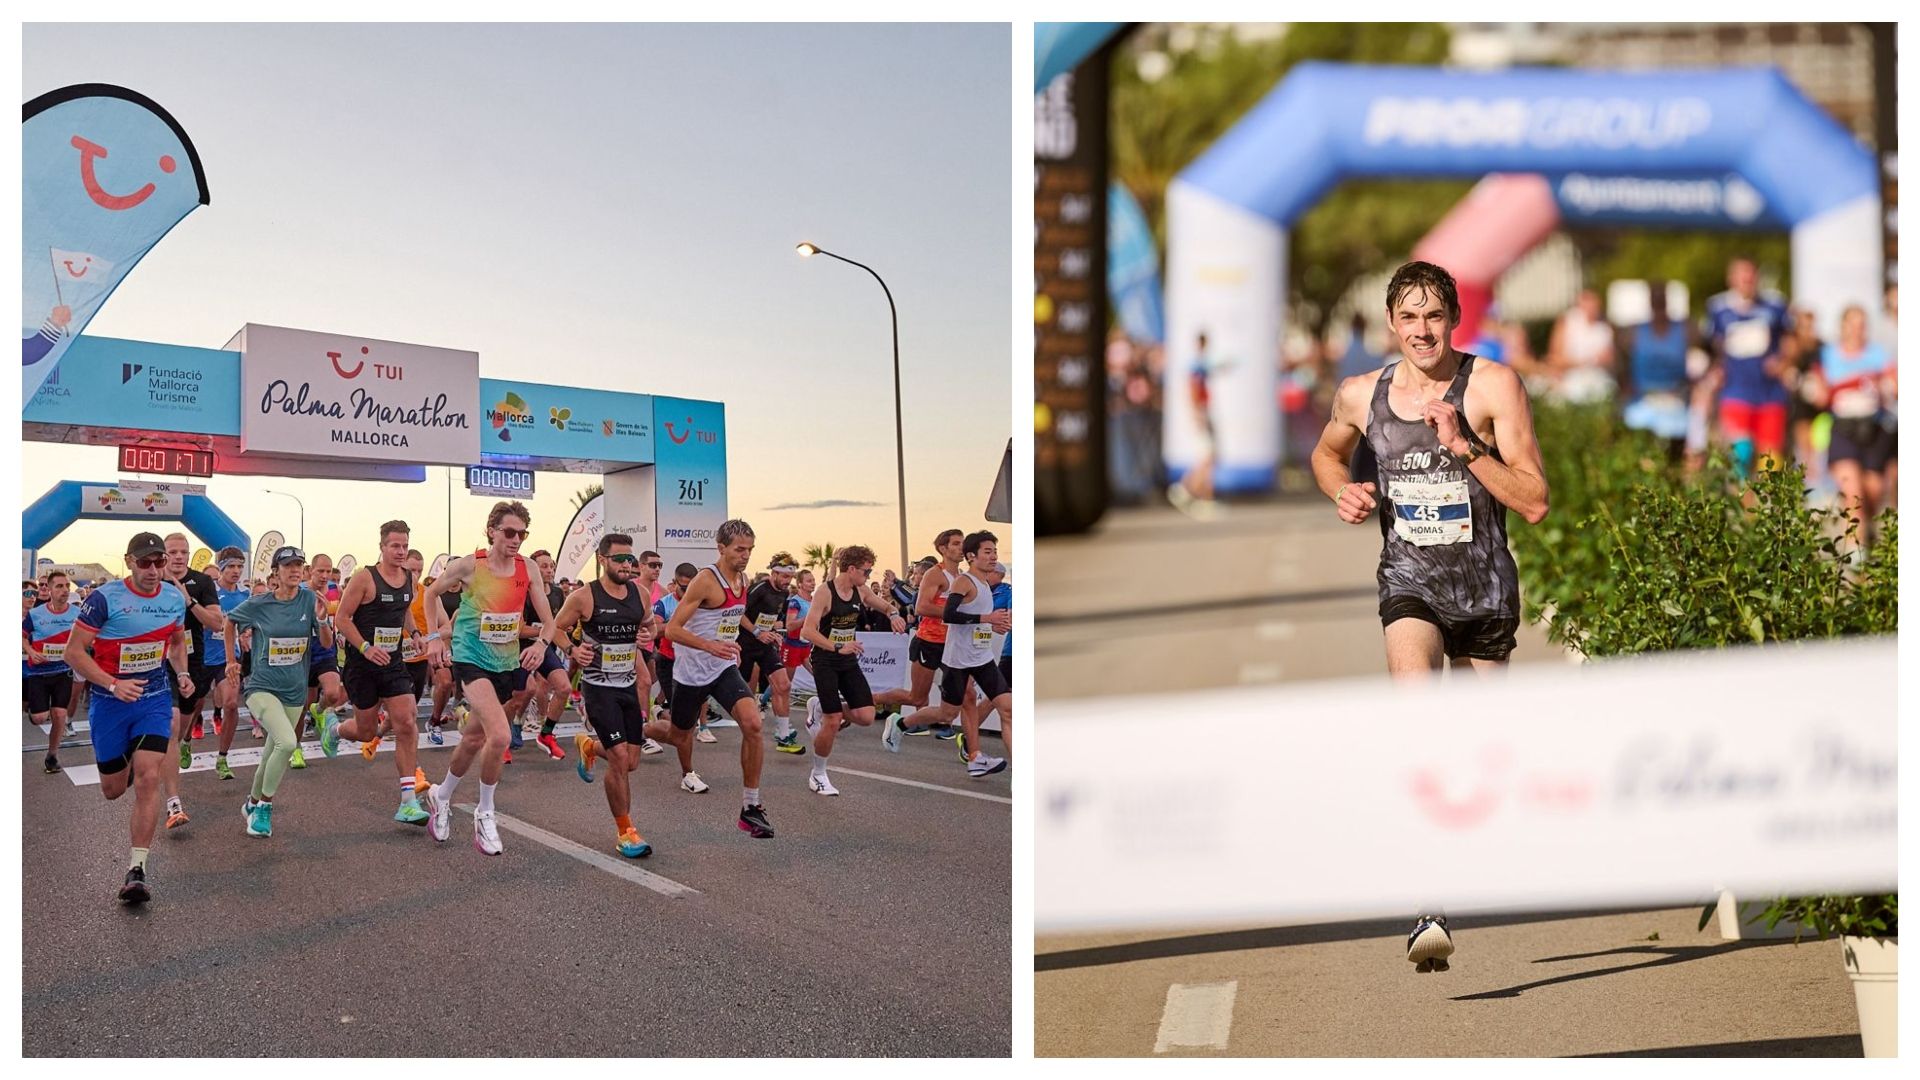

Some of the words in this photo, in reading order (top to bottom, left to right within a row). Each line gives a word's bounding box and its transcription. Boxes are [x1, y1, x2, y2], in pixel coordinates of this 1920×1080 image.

[149, 366, 203, 381] Fundació
[373, 364, 403, 380] TUI
[149, 378, 199, 392] Mallorca
[148, 390, 197, 404] Turisme
[261, 379, 345, 419] Palma
[350, 387, 470, 429] Marathon
[486, 409, 535, 424] Mallorca
[331, 429, 409, 447] MALLORCA
[696, 431, 716, 443] TUI
[1401, 452, 1432, 471] 500
[156, 484, 171, 492] 10K
[1414, 505, 1440, 521] 45
[1408, 526, 1444, 534] THOMAS
[130, 651, 156, 661] 9258
[277, 647, 300, 655] 9364
[610, 653, 632, 662] 9295
